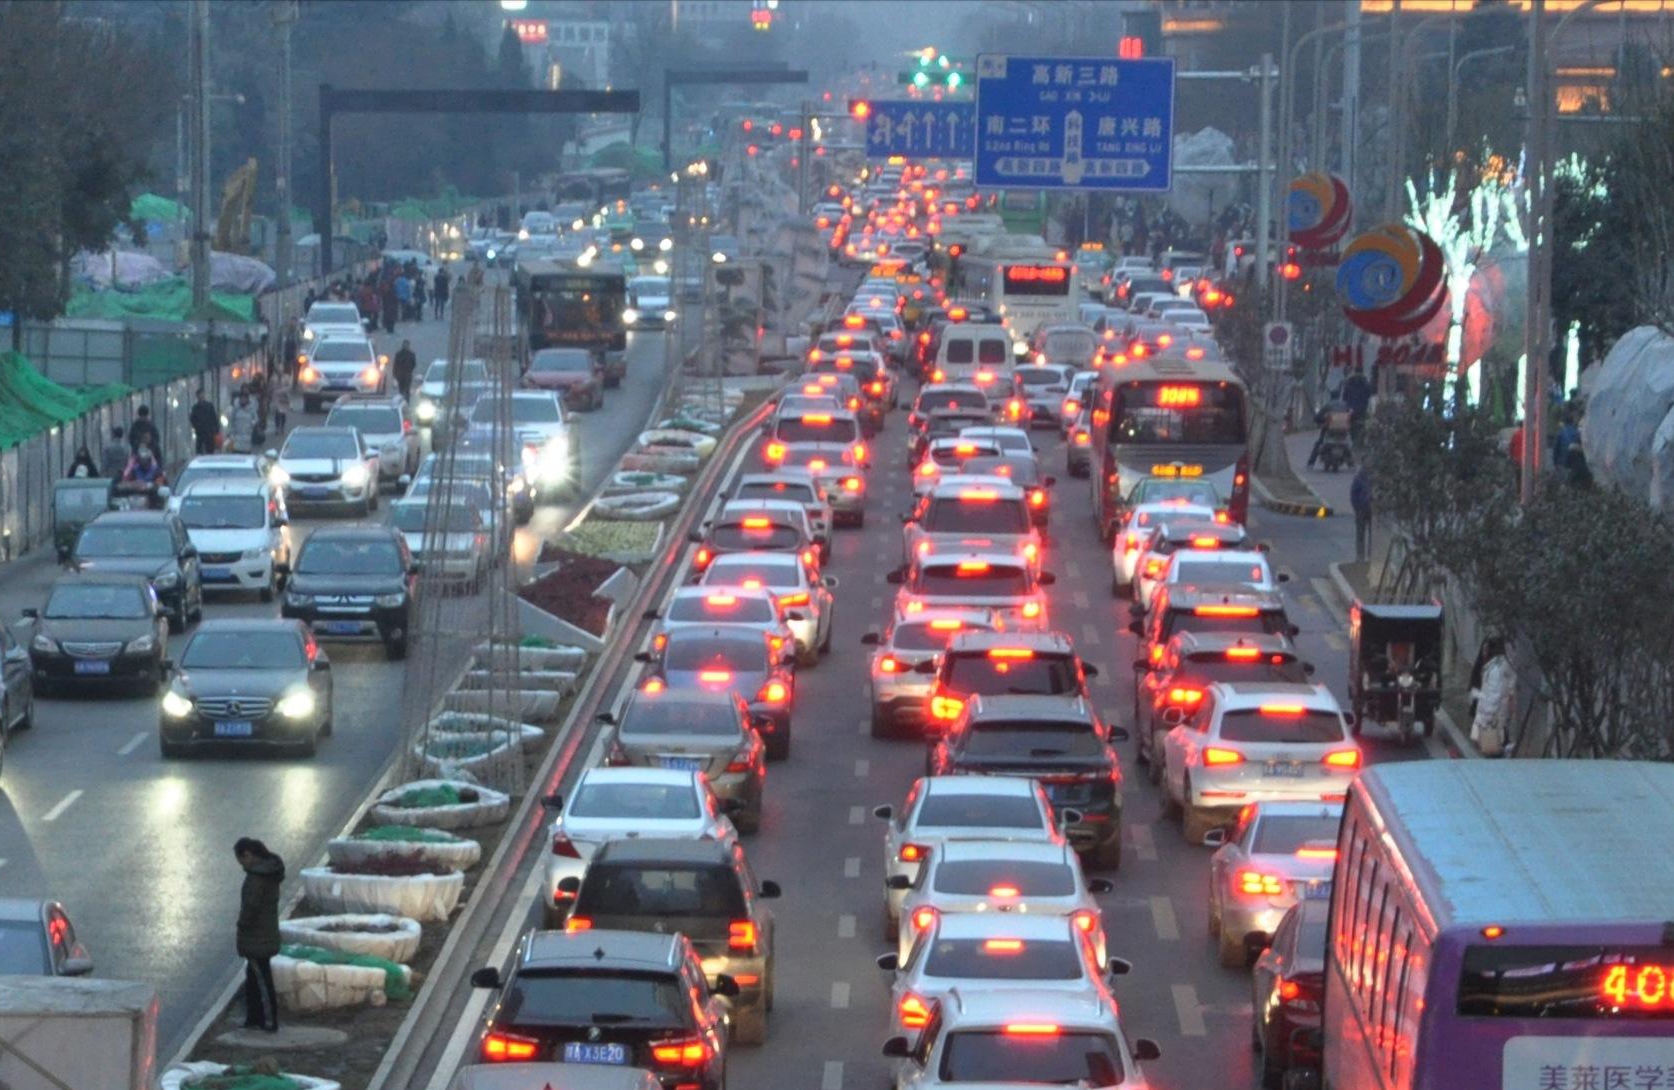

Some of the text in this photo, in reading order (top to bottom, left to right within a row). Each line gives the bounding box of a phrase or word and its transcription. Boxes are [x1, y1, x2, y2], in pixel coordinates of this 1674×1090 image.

[1032, 64, 1118, 86] 高新三路
[986, 115, 1051, 135] 南二环
[1097, 117, 1162, 138] 唐兴路
[1604, 964, 1674, 1004] 40
